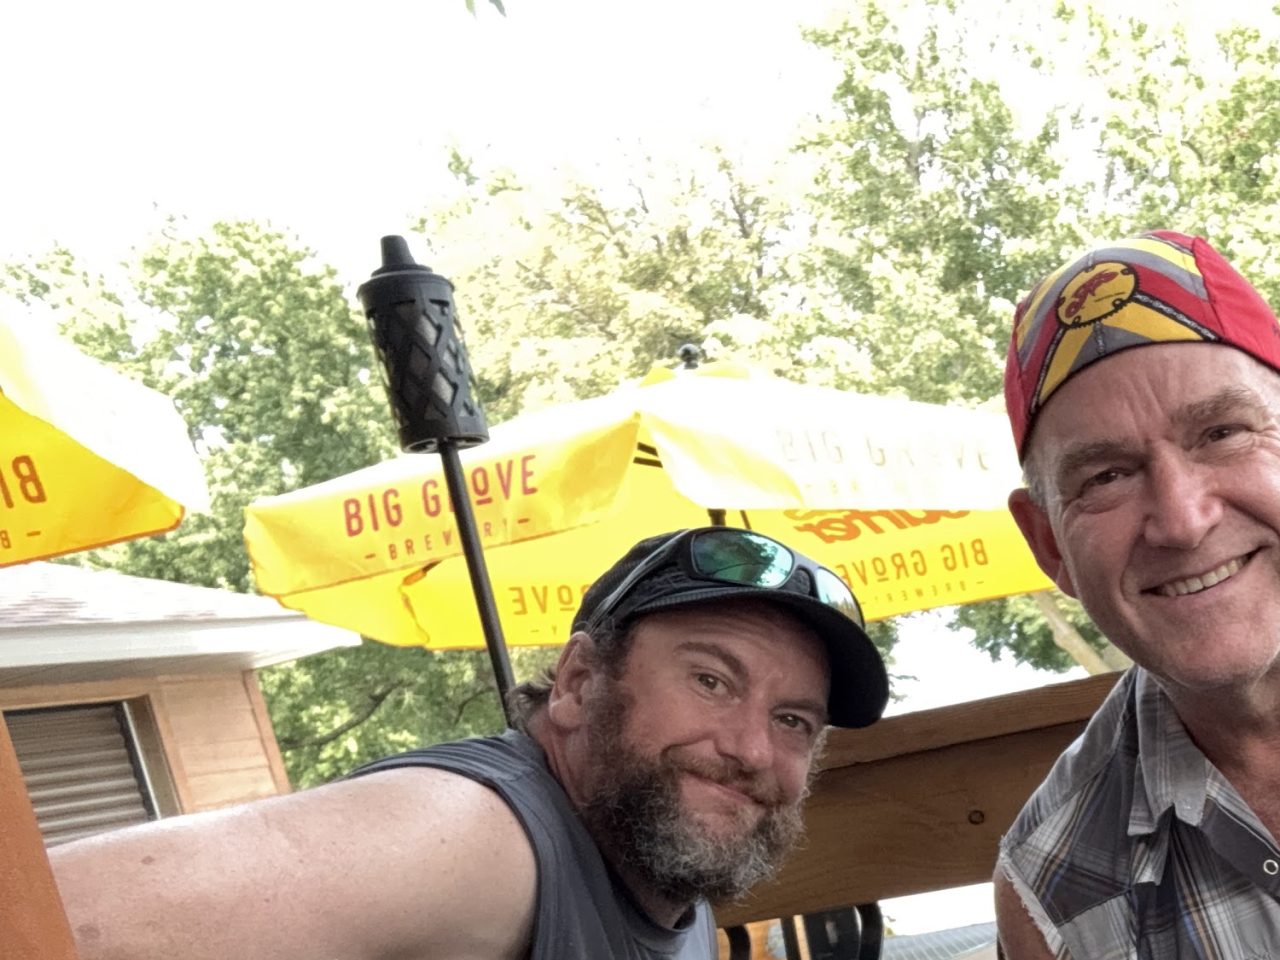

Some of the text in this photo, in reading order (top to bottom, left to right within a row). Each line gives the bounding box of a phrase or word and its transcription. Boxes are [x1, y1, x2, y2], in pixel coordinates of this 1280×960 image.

[343, 454, 538, 537] BIG GOVE
[388, 518, 508, 560] BREWRY
